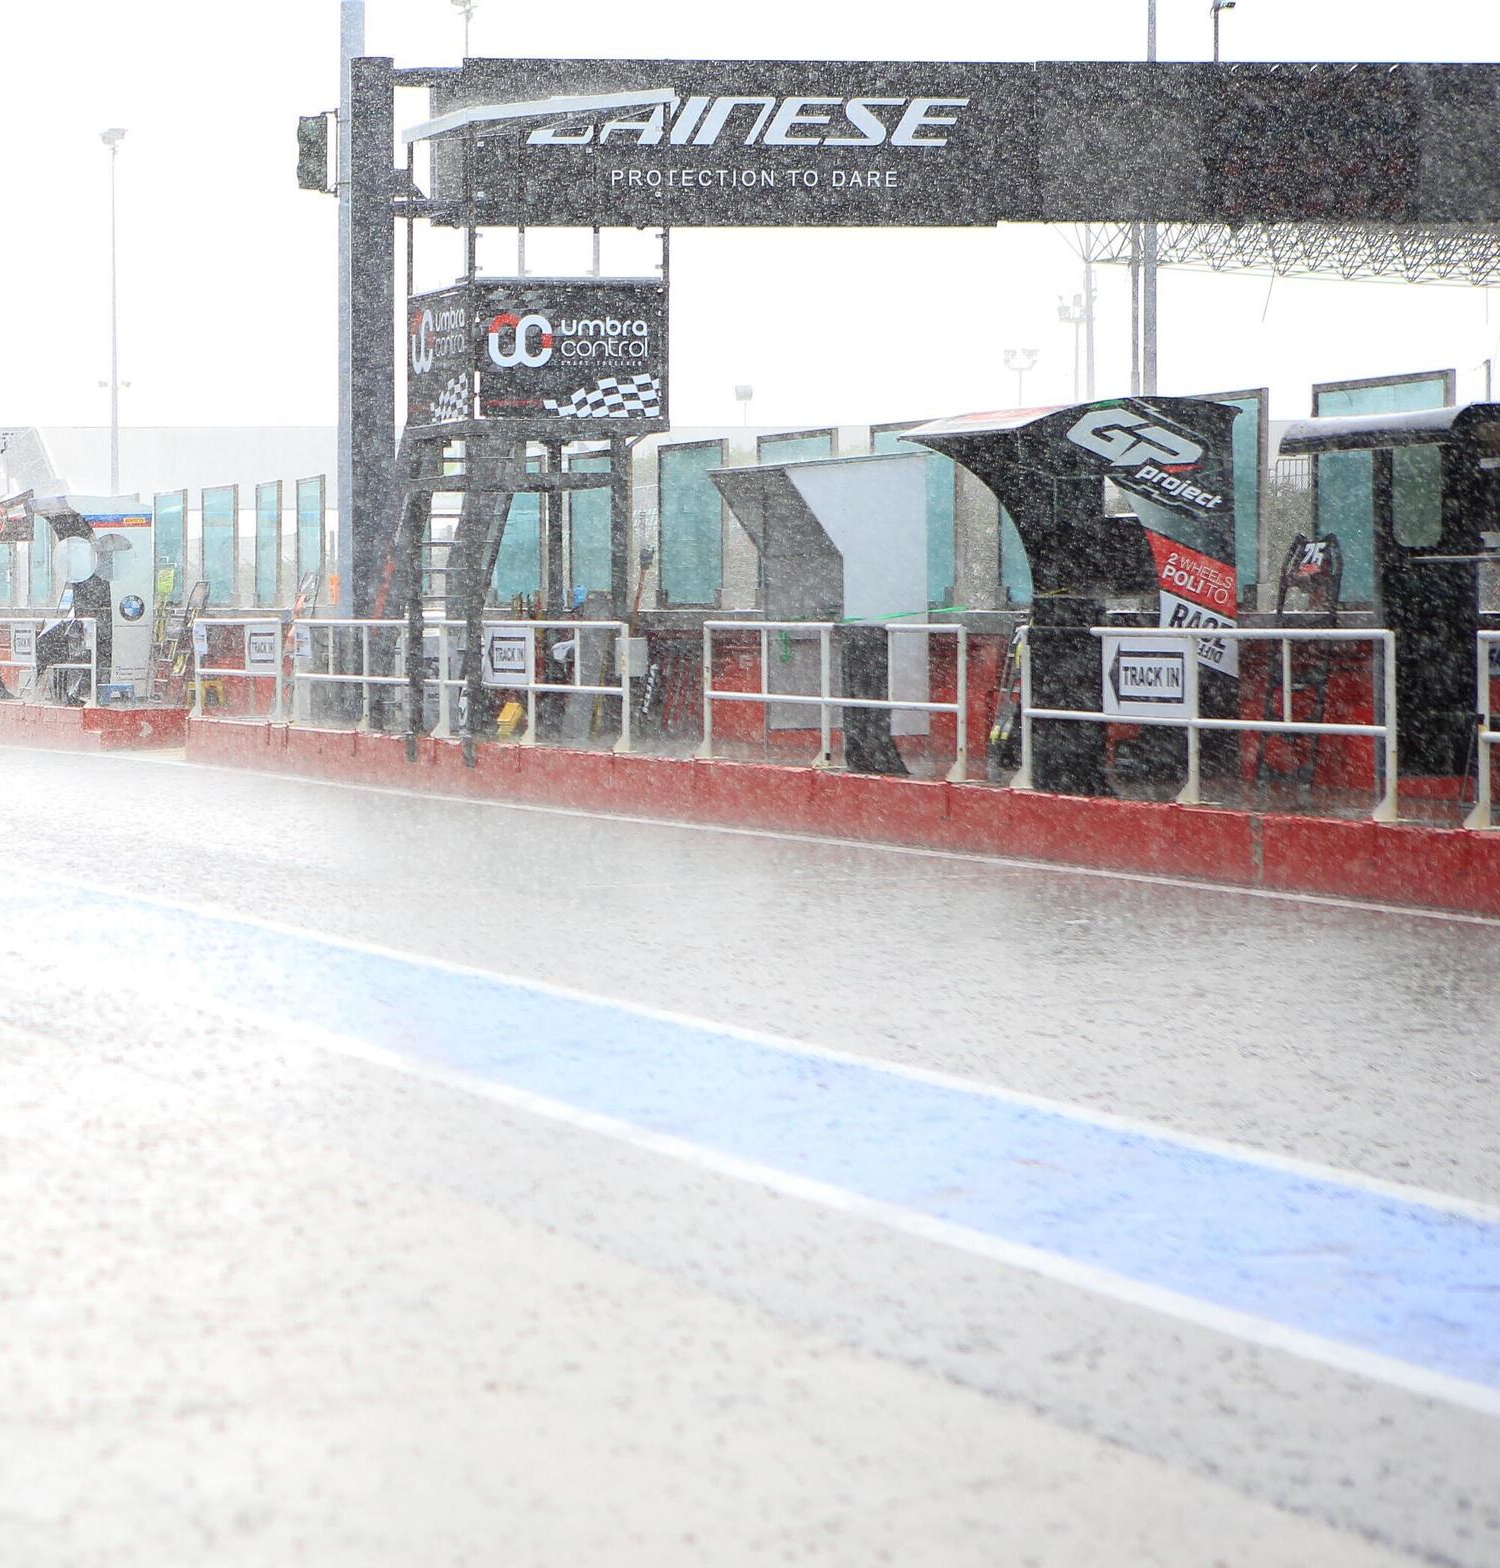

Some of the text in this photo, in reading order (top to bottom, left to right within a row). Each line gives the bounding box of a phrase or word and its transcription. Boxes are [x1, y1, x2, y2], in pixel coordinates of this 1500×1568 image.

[611, 169, 899, 188] PROTECTION TO DARE
[435, 308, 465, 332] umbra
[561, 316, 648, 336] umbra
[561, 338, 648, 357] control
[1066, 408, 1203, 467] GP
[1135, 466, 1223, 508] project
[1167, 552, 1234, 589] 2 WHEELS
[495, 647, 524, 662] TRACK IN
[1122, 665, 1180, 688] TRACK IN
